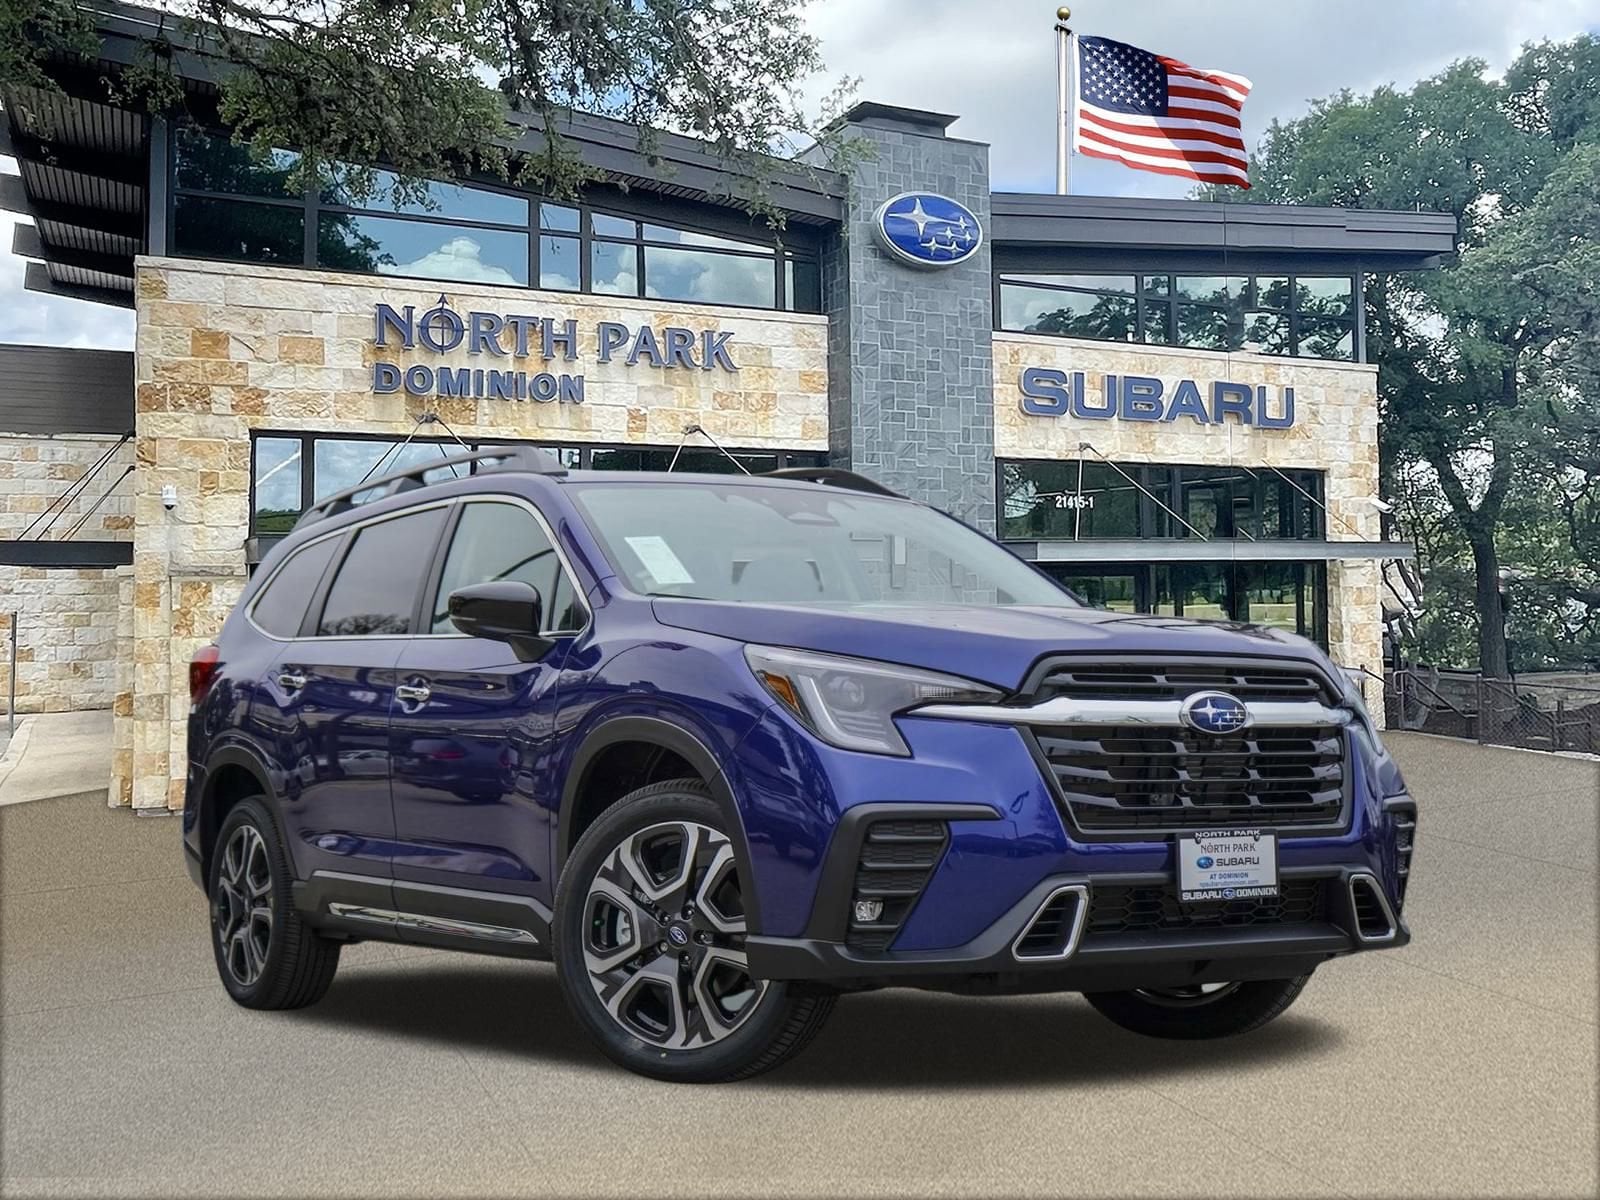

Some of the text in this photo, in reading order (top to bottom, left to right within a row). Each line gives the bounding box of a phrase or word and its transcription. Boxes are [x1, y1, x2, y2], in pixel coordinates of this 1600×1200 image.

[375, 293, 741, 373] NORTH PARK
[372, 362, 585, 403] DOMINION
[1018, 367, 1295, 430] SUBARU
[1200, 843, 1256, 854] NORTH PARK
[1216, 857, 1260, 866] SUBARU
[1218, 872, 1249, 880] DOMINION
[1182, 887, 1278, 900] SUBARU DOMINION
